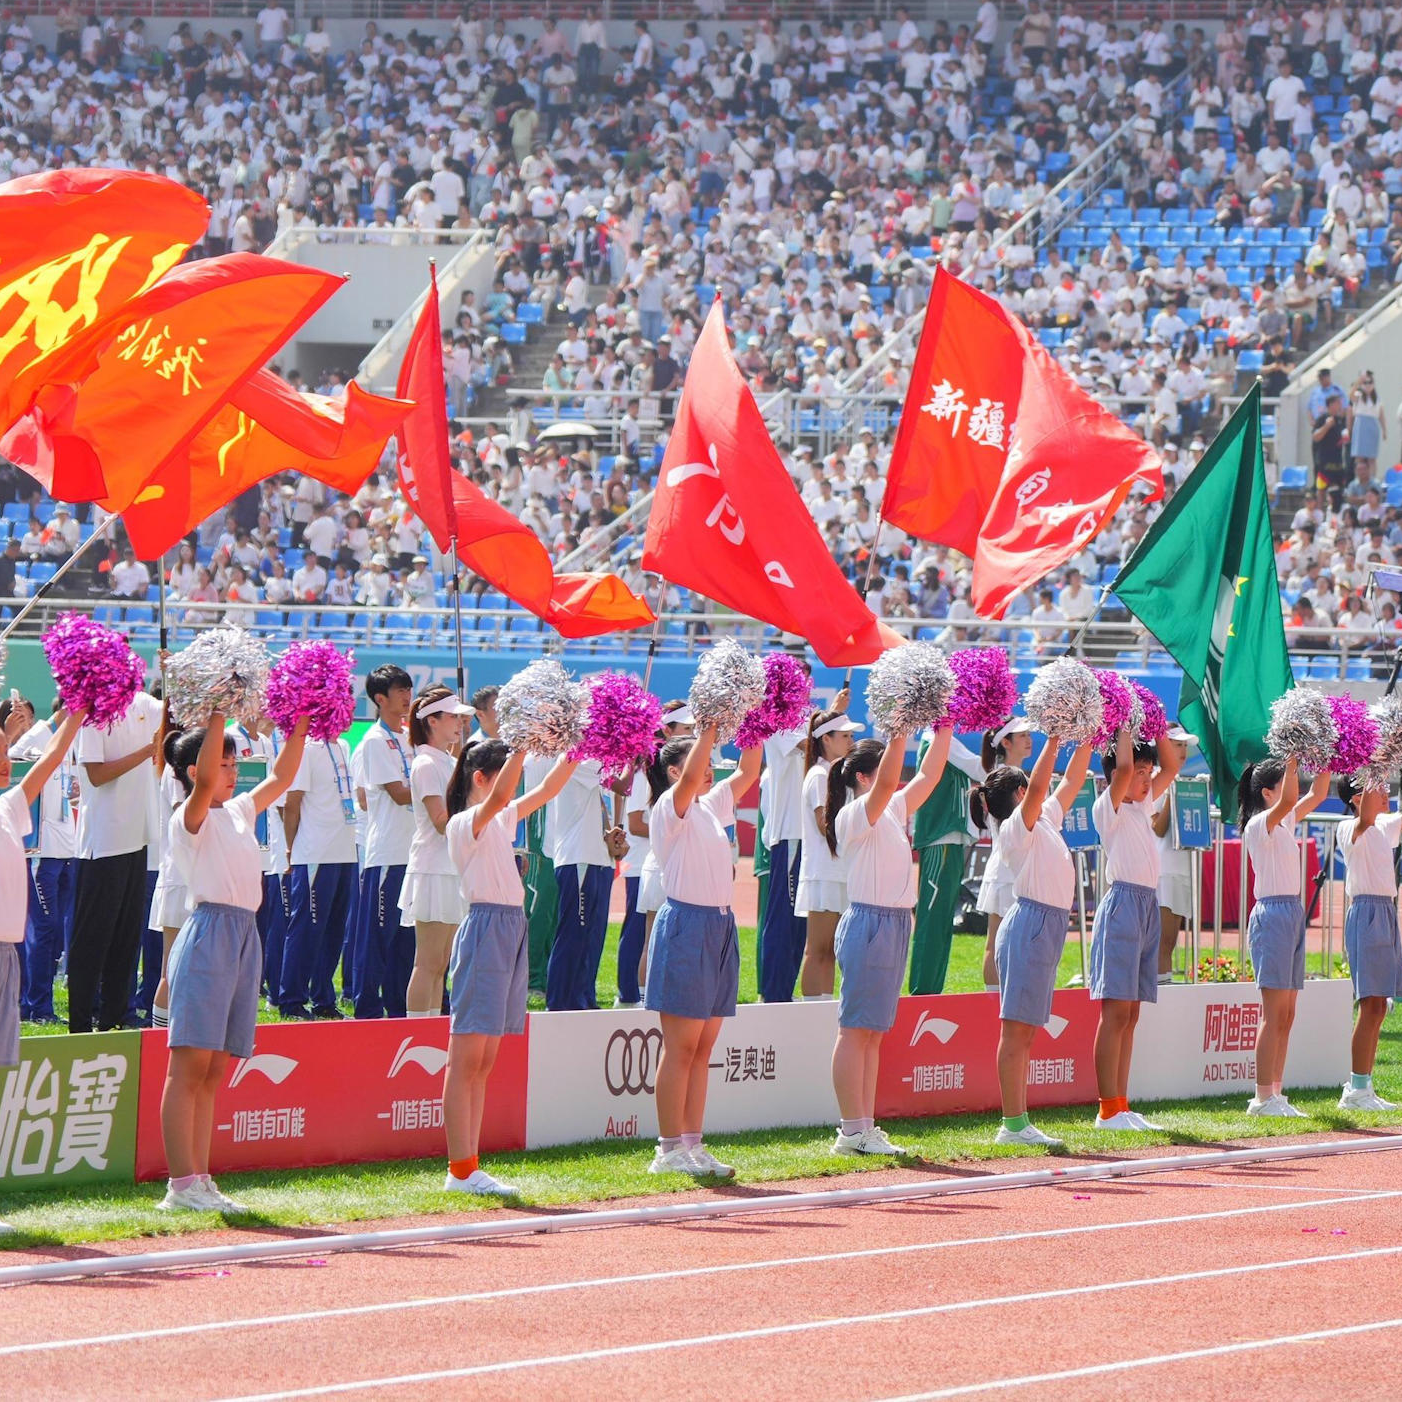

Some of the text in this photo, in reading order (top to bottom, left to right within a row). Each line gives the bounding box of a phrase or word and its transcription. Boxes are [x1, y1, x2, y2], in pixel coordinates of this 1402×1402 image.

[1202, 1003, 1263, 1053] 阿迪雷
[708, 1044, 777, 1083] 一汽奥迪
[901, 1062, 965, 1094] 一切皆有可能
[217, 1107, 306, 1143] 一切皆有可能
[604, 1114, 638, 1139] Audi
